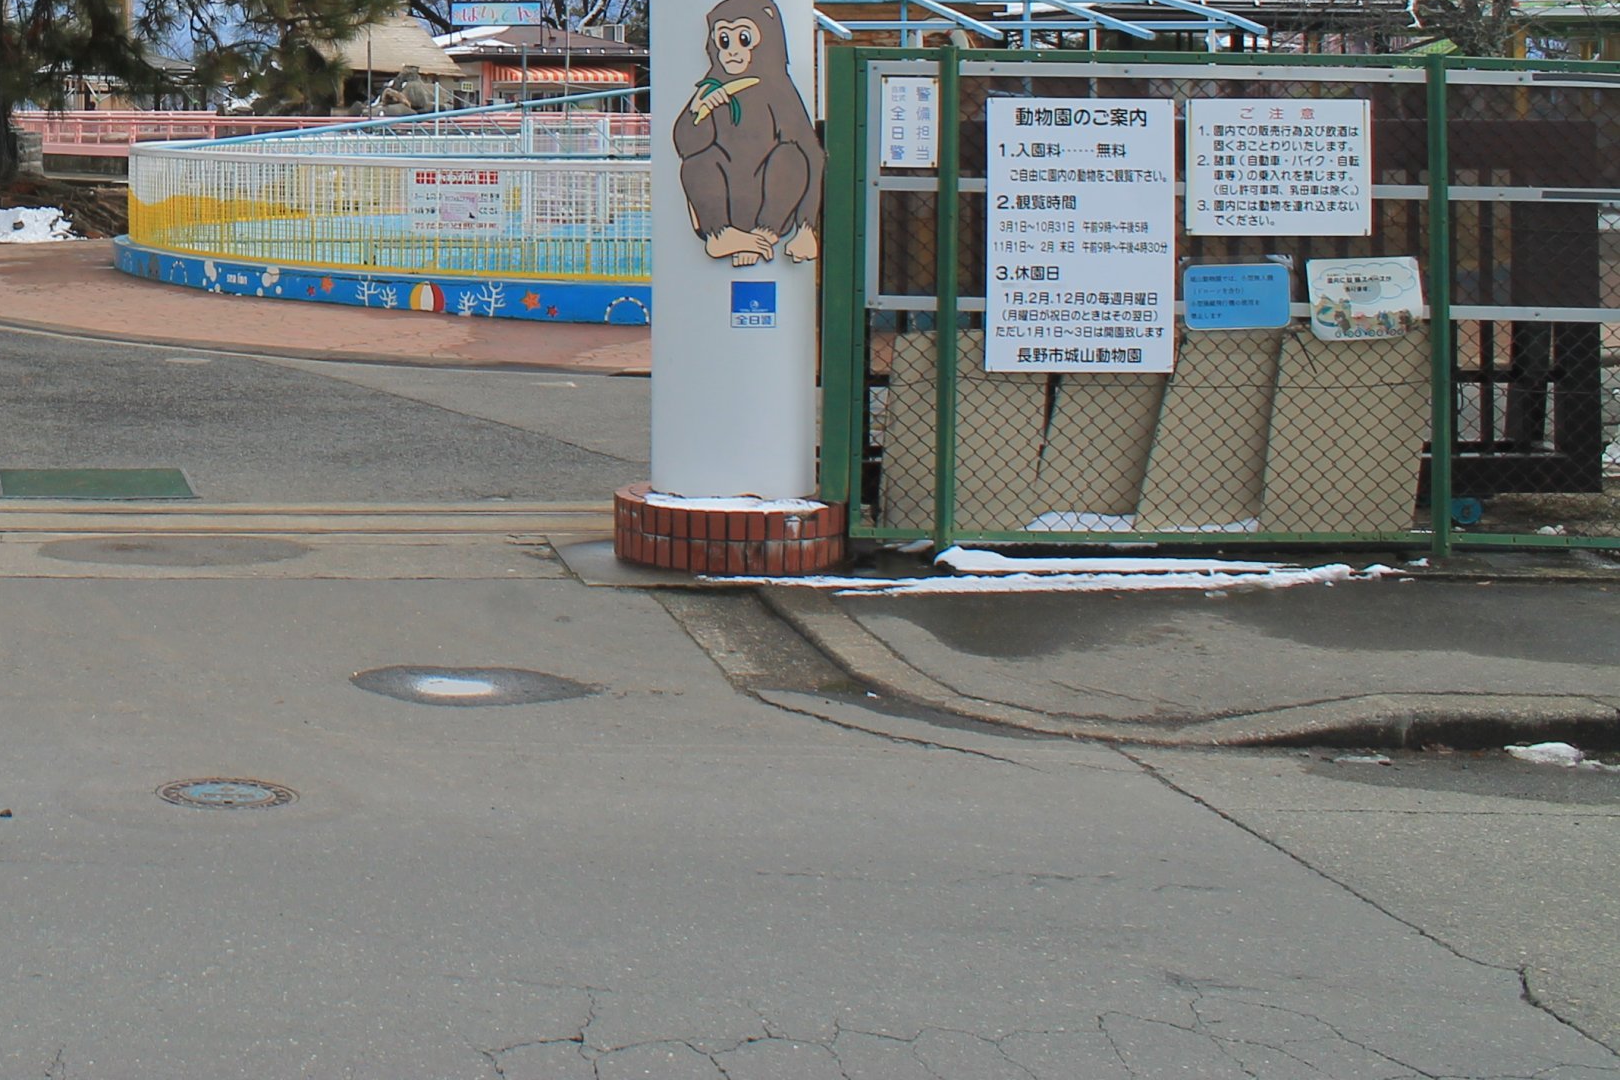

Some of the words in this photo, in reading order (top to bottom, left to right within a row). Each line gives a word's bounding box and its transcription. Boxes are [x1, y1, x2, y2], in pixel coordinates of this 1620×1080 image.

[1015, 107, 1148, 127] 動物園のご案内
[1213, 140, 1354, 152] 固くおことわりいたします。
[1214, 215, 1275, 226] でください。
[995, 266, 1060, 281] 3.休園日
[1017, 348, 1143, 363] 長野市城山動物園
